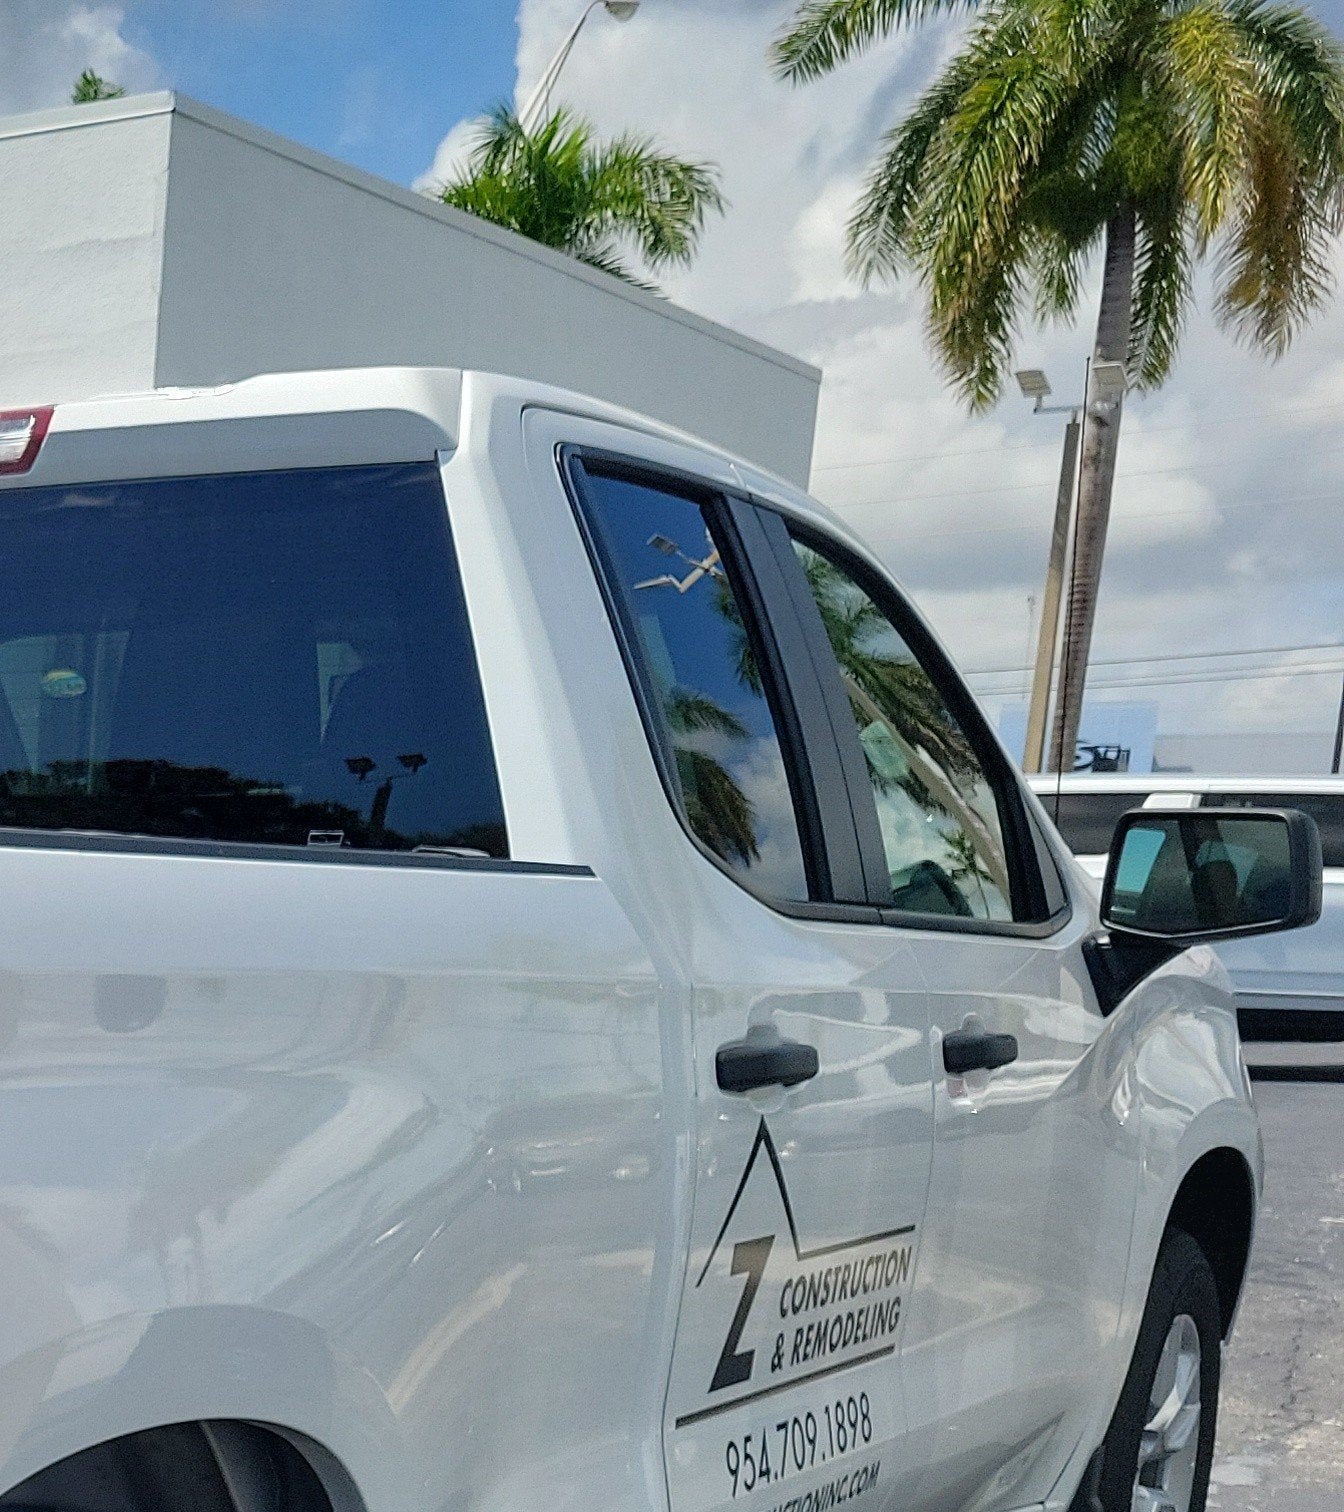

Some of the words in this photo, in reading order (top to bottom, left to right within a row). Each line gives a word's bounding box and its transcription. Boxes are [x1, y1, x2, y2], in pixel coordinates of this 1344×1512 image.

[707, 1233, 776, 1395] Z
[779, 1246, 913, 1319] CONSTRUCTION
[770, 1332, 786, 1374] &
[790, 1296, 902, 1367] REMODELING
[725, 1391, 873, 1500] 954.709.1898
